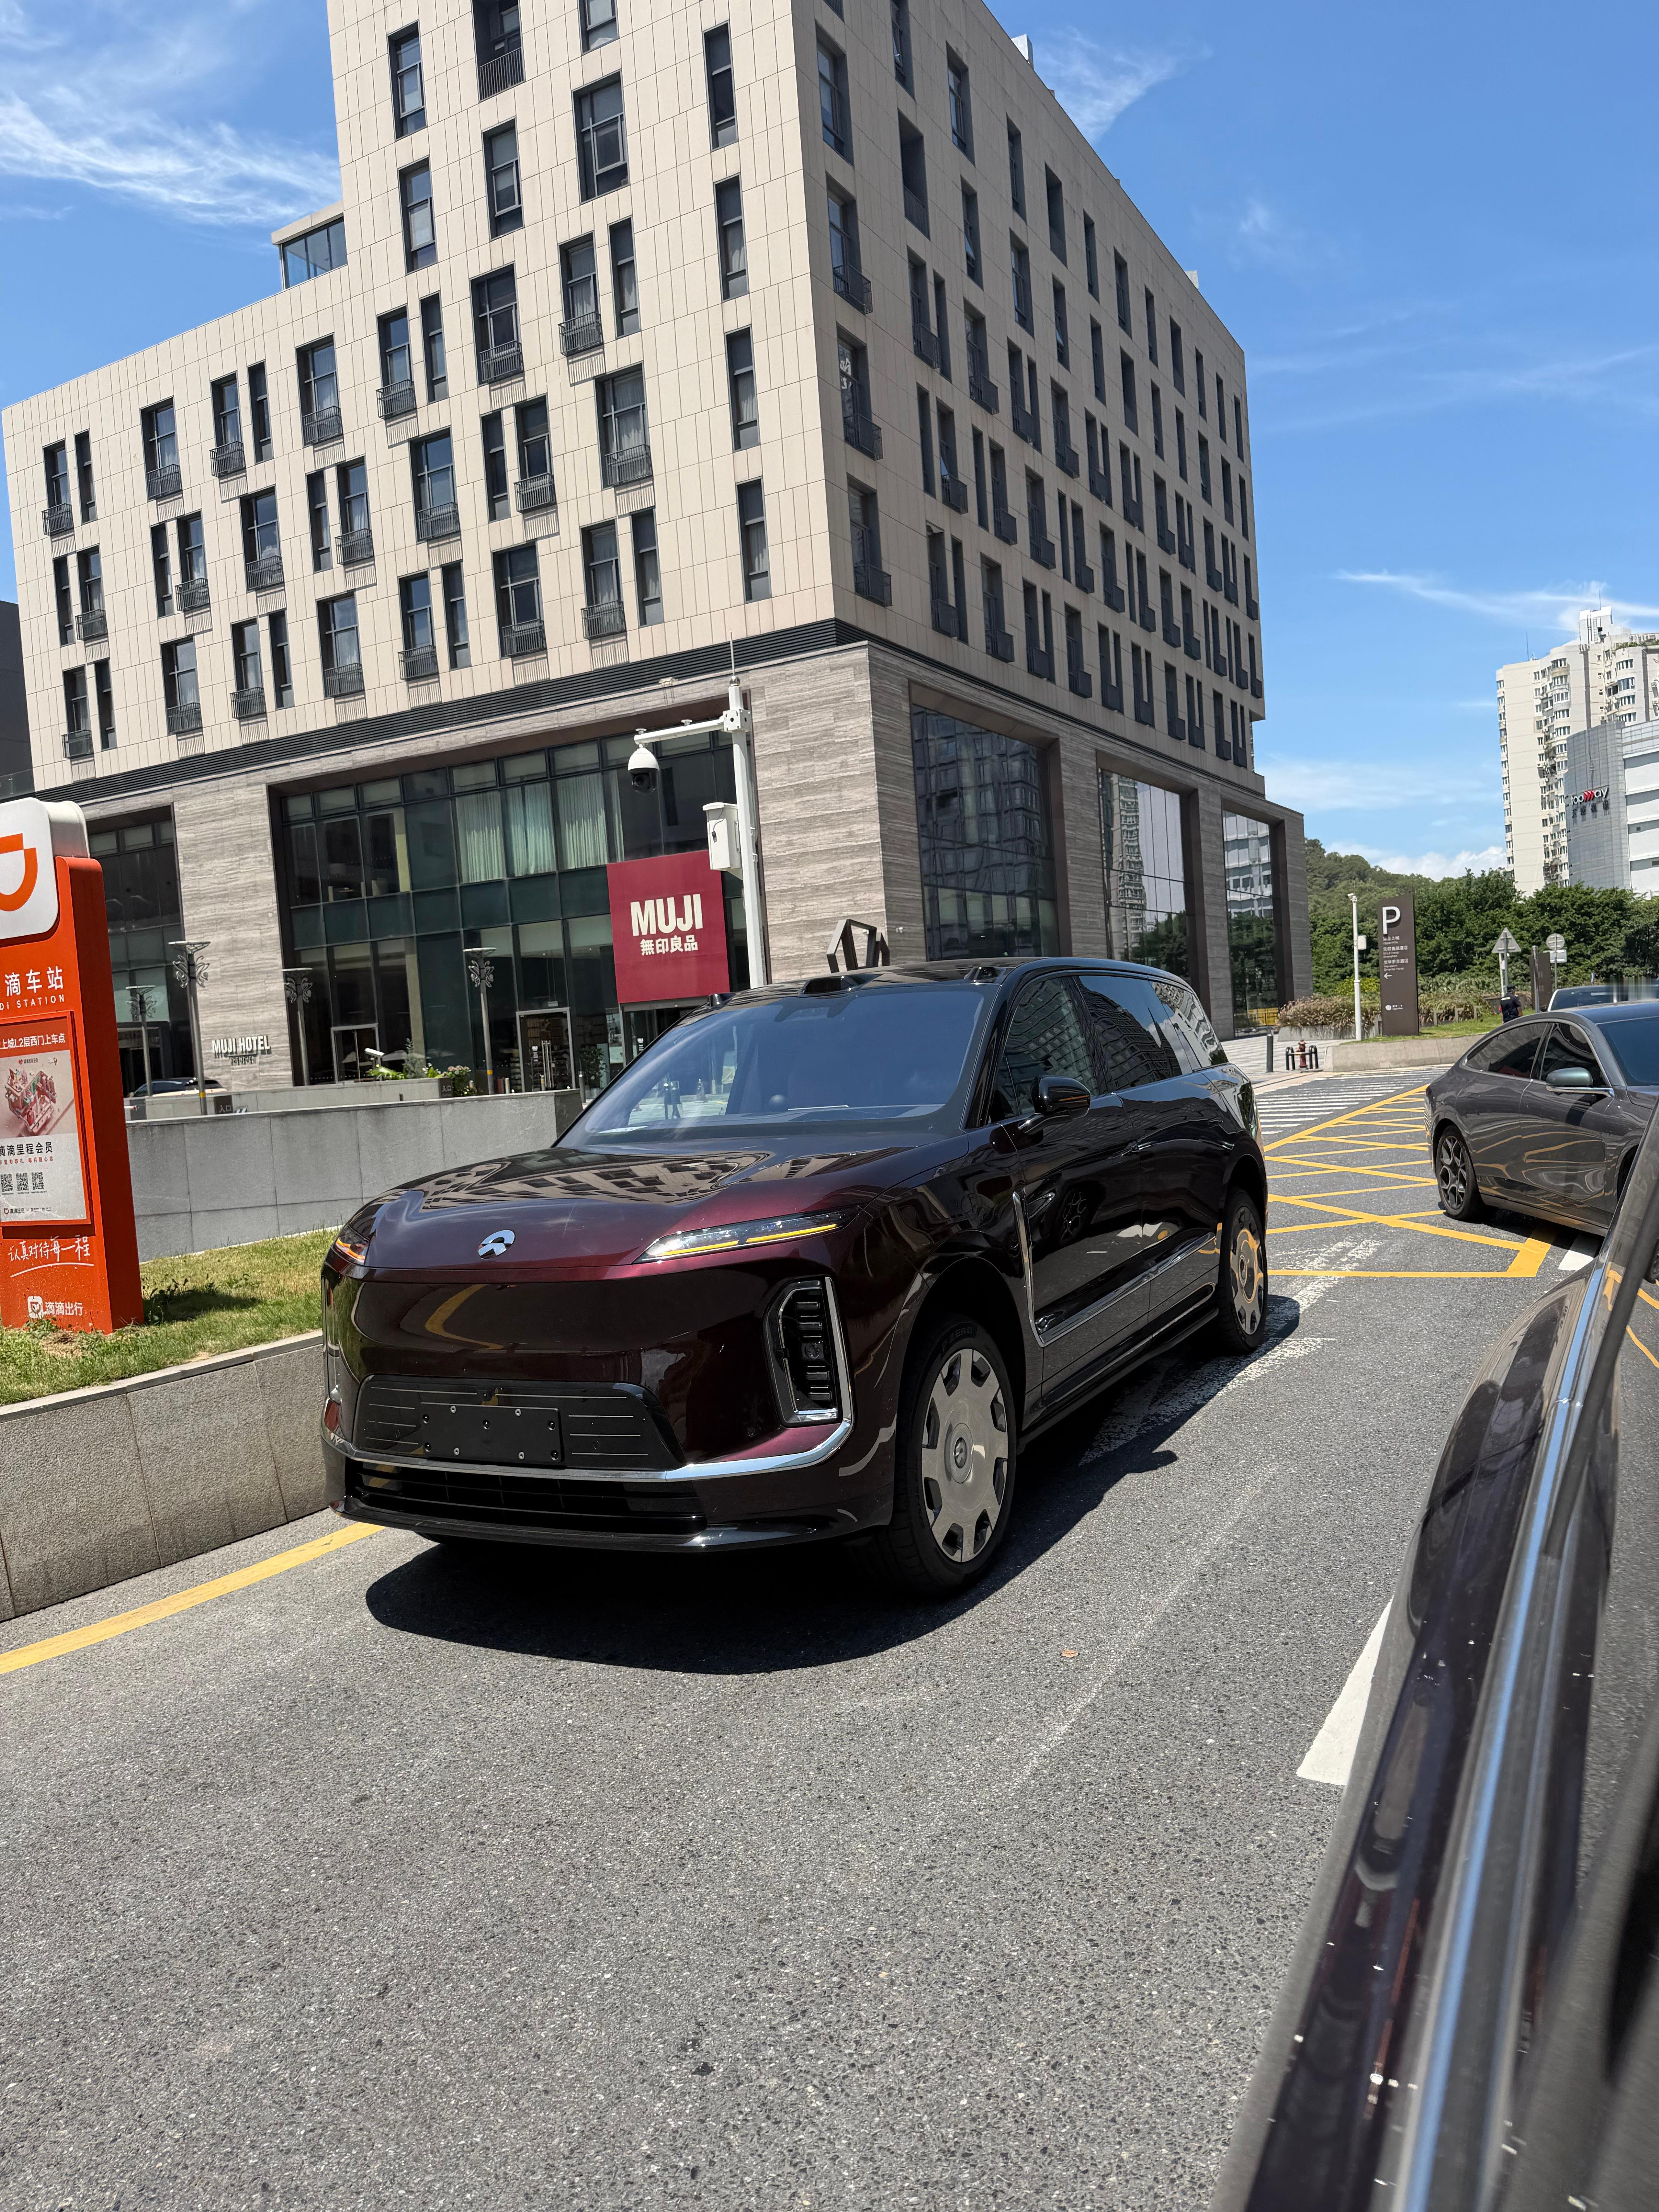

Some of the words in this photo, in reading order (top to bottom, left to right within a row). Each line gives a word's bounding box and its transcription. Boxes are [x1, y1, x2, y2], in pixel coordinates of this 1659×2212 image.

[630, 894, 703, 936] MUJI
[1382, 906, 1401, 935] P
[640, 934, 698, 956] 無印良品
[17, 994, 64, 1008] STATION
[0, 1033, 66, 1050] 上城L2层西门上车点
[212, 1038, 236, 1053] MUJI
[238, 1035, 270, 1052] HOTEL
[219, 1105, 232, 1113] 入口
[8, 1235, 91, 1262] 认真对待每一程
[45, 1301, 83, 1316] 滴滴出行
